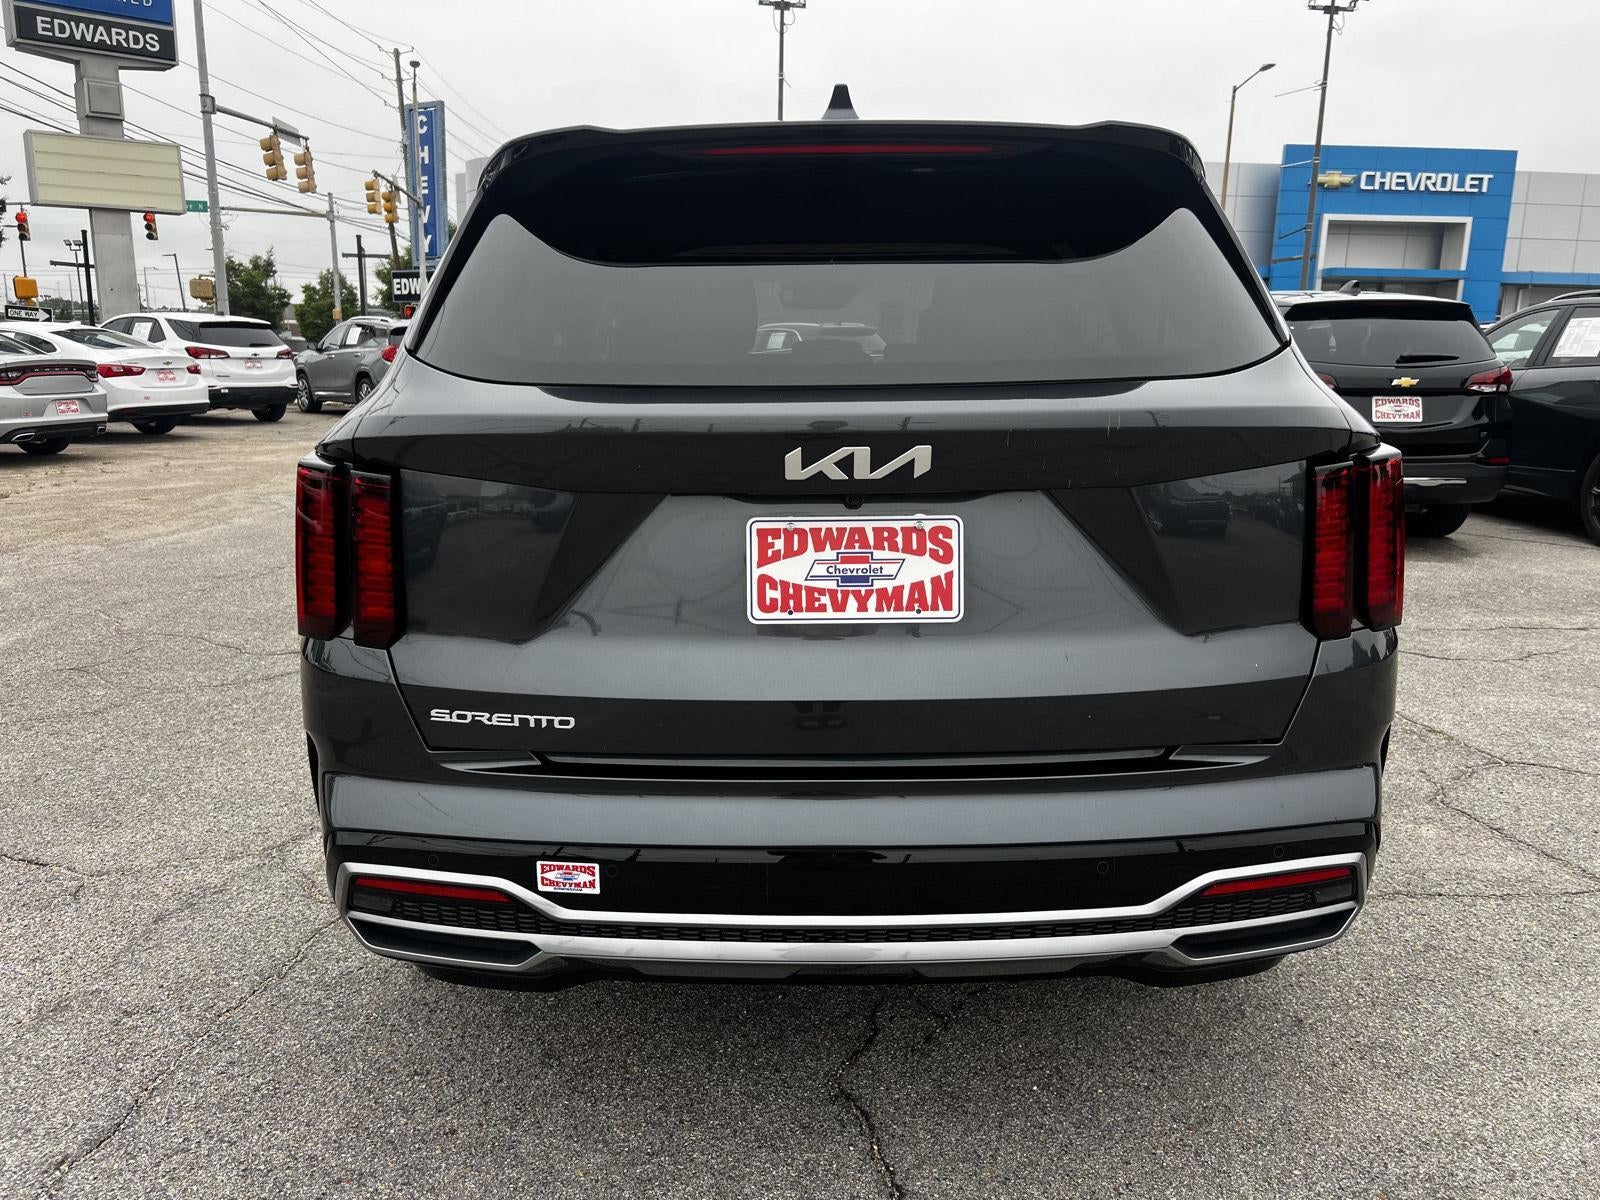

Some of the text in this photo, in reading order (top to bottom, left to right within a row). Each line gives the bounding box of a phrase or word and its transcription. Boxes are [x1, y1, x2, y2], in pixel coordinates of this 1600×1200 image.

[36, 15, 160, 52] EDWARDS
[418, 114, 432, 253] CHEVY
[1360, 171, 1494, 193] CHEVROLET
[9, 309, 38, 319] ONE WAY
[1375, 398, 1420, 408] EDWARDS
[1375, 409, 1420, 420] CHEVYMAN
[785, 445, 932, 480] KIA
[756, 525, 954, 568] EDWARDS
[826, 565, 884, 575] Chevrolet
[756, 570, 954, 613] CHEVYMAN
[430, 708, 576, 730] SORENTO
[540, 864, 596, 877] EDWARDS
[540, 876, 596, 889] CHEVYMAN
